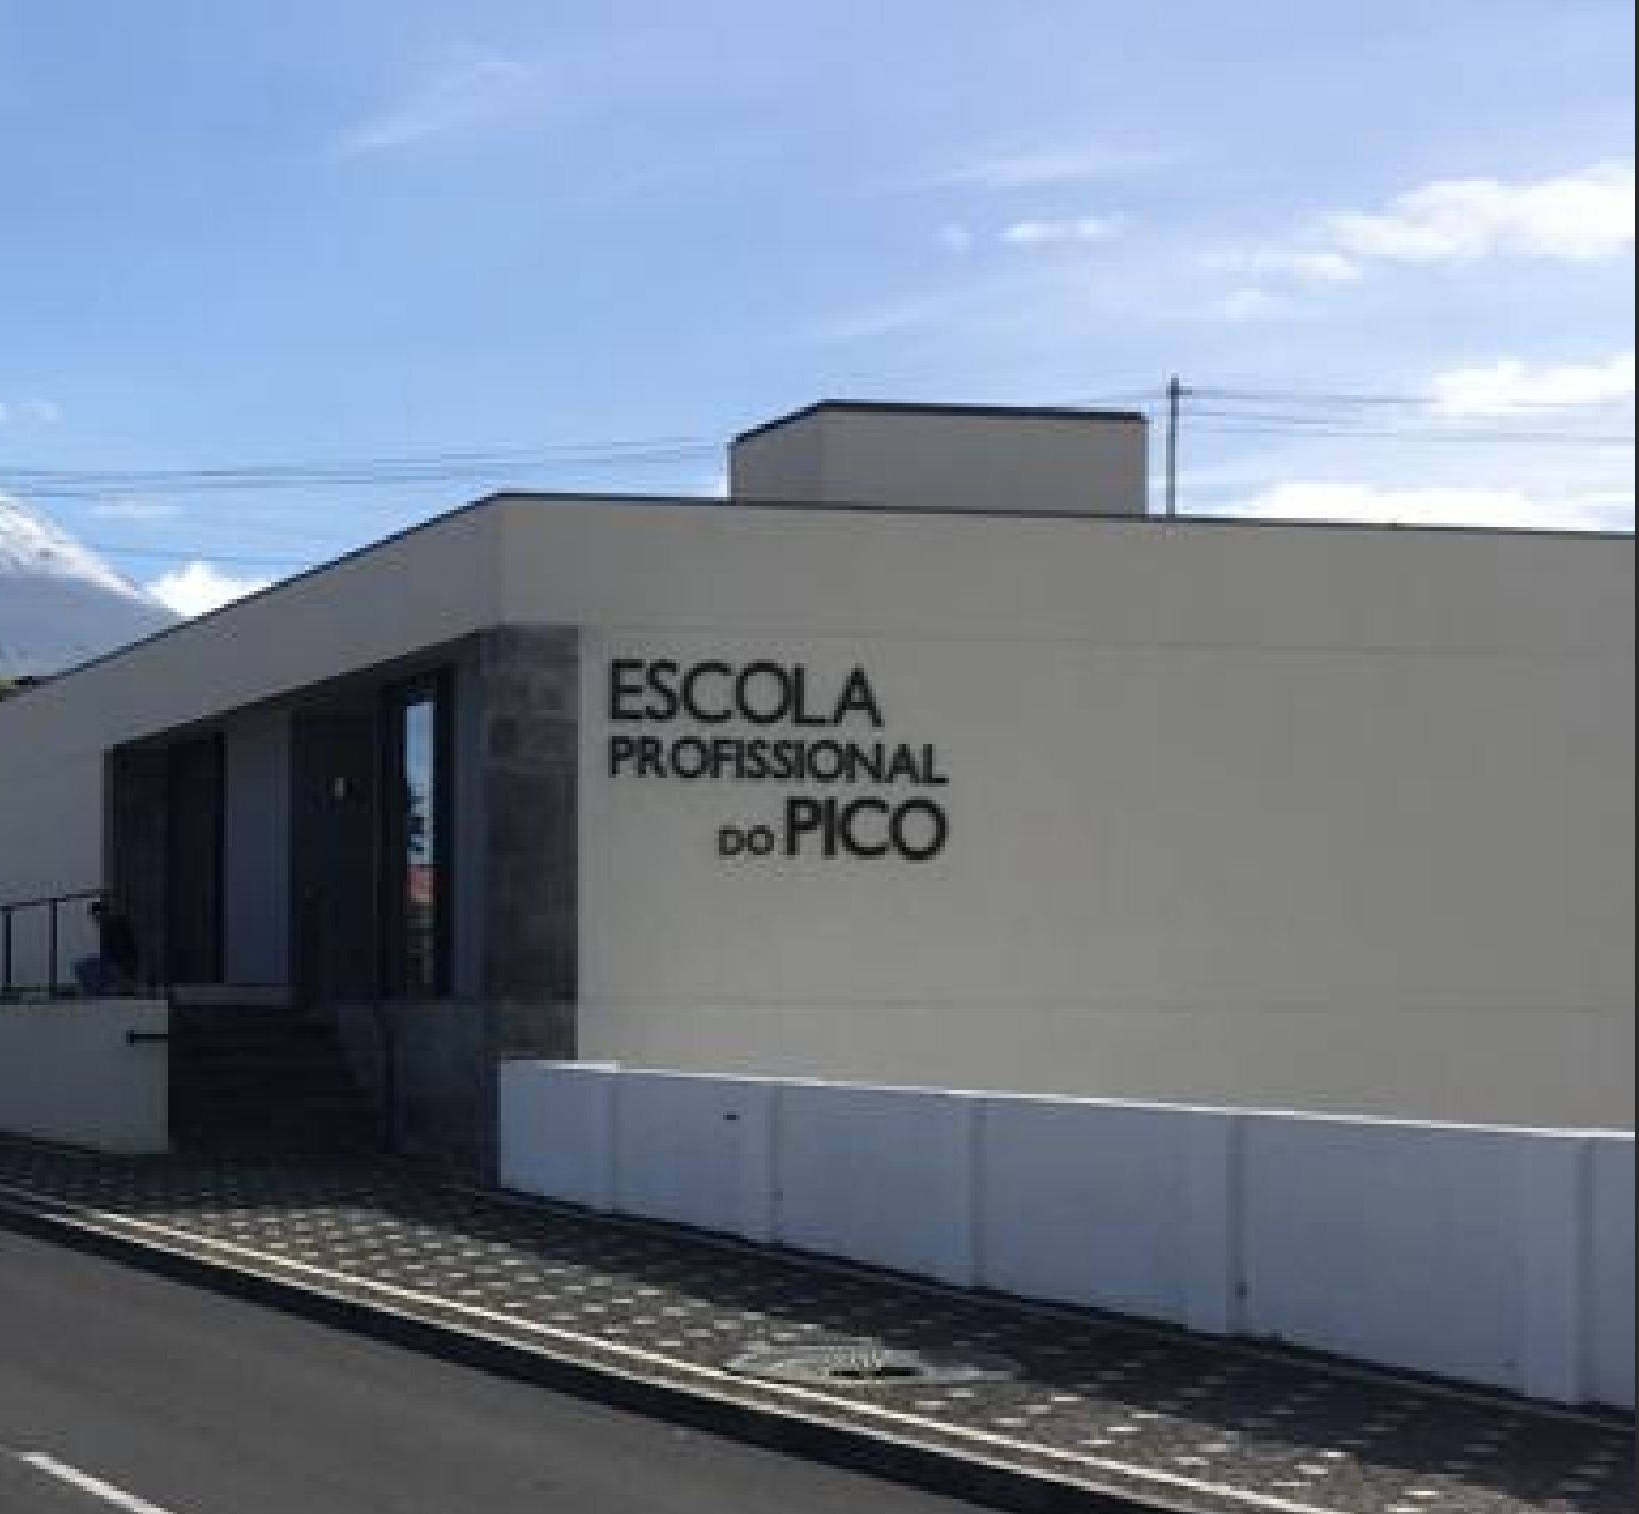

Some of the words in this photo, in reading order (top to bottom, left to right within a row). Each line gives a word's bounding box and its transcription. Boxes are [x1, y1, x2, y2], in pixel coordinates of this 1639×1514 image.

[609, 658, 885, 727] ESCOLA
[608, 736, 950, 783] PROFISSIONAL
[717, 824, 776, 857] DO
[785, 795, 950, 862] PICO
